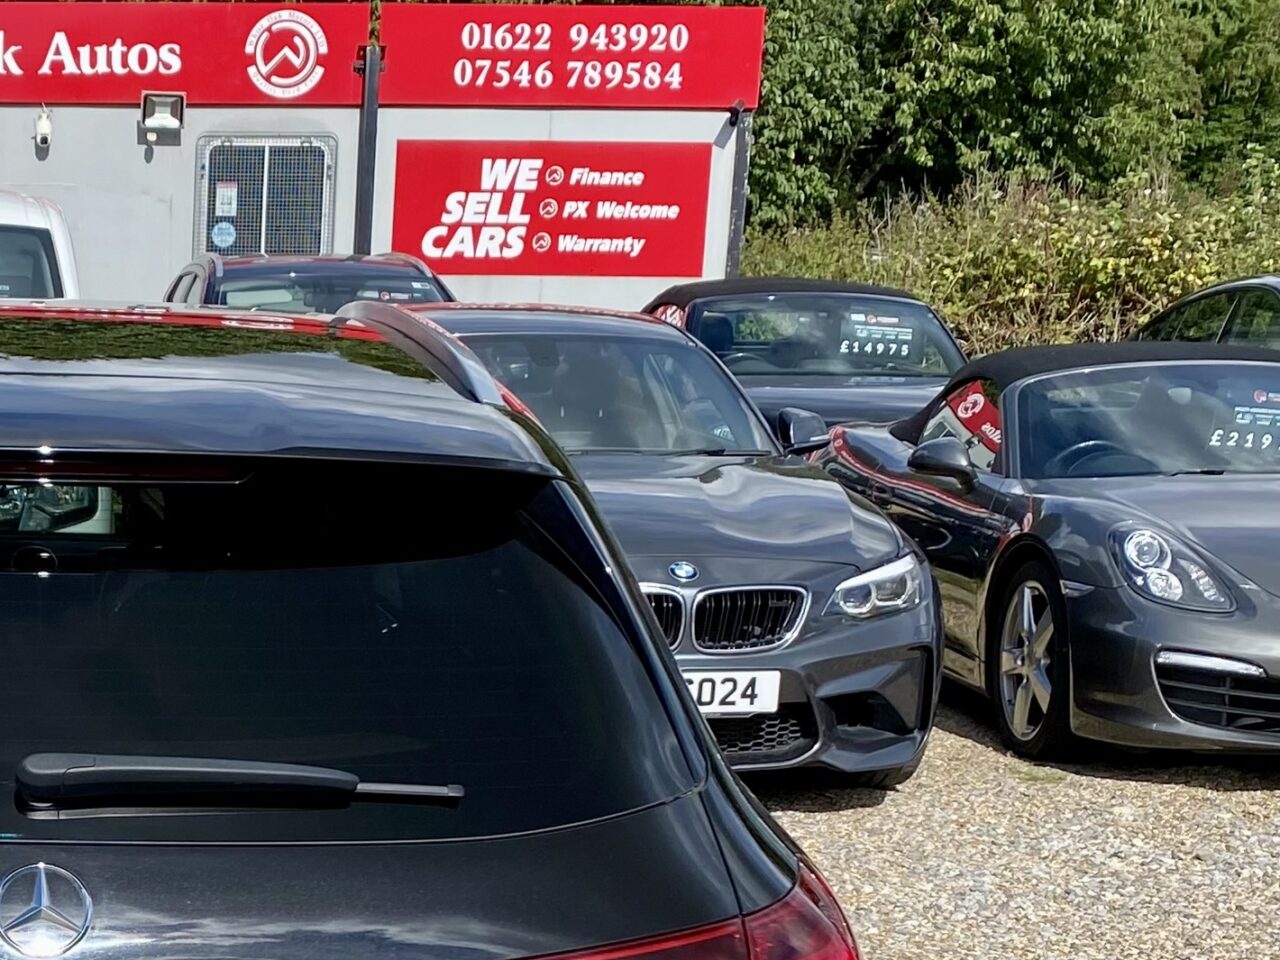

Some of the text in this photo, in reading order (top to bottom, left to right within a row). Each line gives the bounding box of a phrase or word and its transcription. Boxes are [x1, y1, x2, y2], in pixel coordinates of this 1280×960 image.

[462, 23, 688, 51] 01622 943920
[38, 32, 181, 74] Autos
[454, 59, 682, 89] 07546 789584
[481, 159, 543, 190] WE
[570, 168, 644, 185] Finance
[441, 192, 530, 224] SELL
[563, 201, 679, 218] PX Welcome
[422, 226, 524, 258] CARS
[558, 235, 645, 256] Warranty
[840, 340, 909, 356] £14975
[1209, 429, 1280, 451] £219
